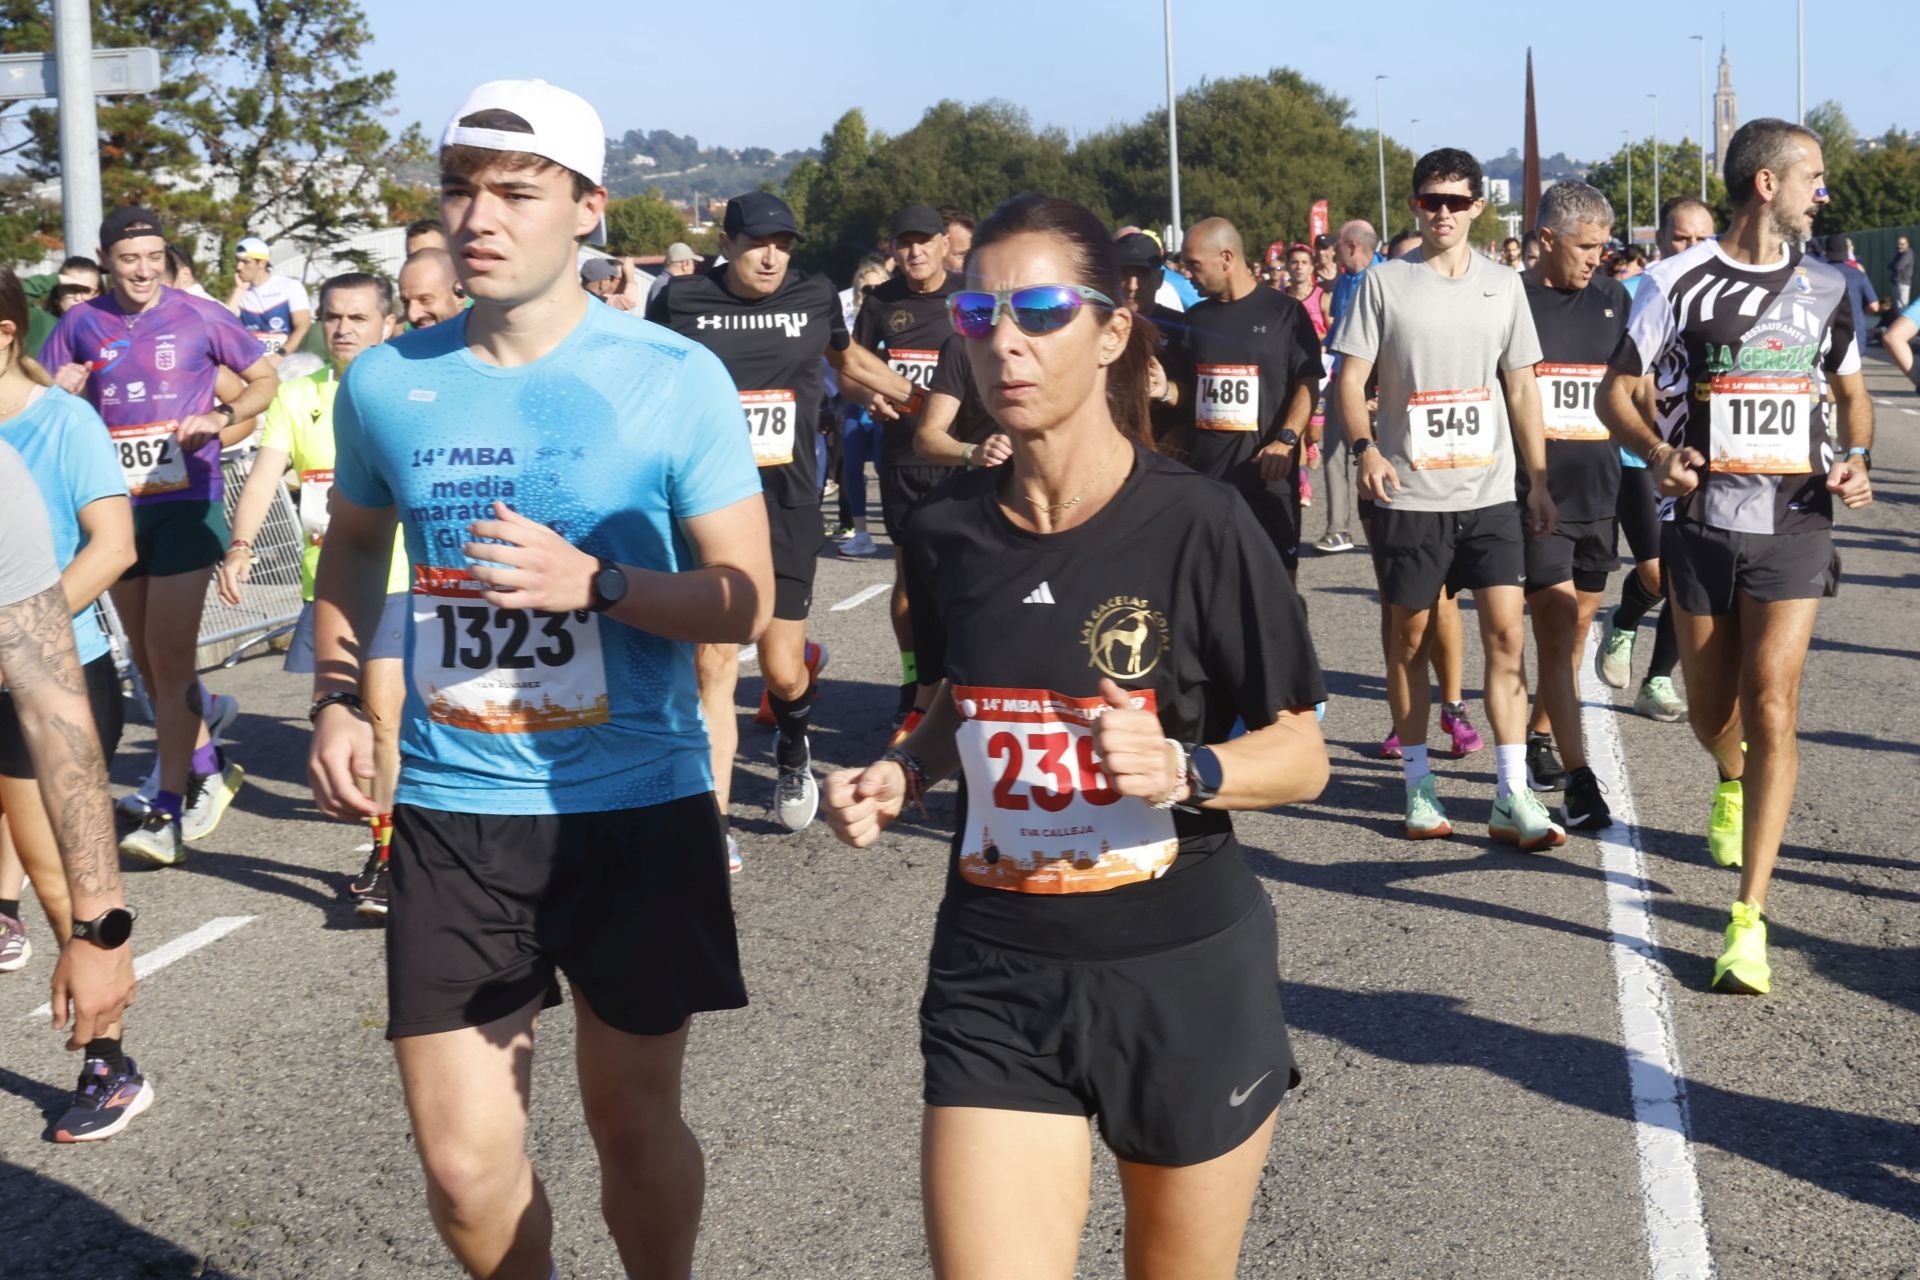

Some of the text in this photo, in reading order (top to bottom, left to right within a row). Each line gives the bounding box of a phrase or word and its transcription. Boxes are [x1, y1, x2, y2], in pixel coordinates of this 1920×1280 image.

[1739, 322, 1808, 343] RESTAURANTE
[1704, 342, 1820, 373] LA CEREZA
[1202, 378, 1250, 405] 1486
[1426, 405, 1480, 438] 549
[1729, 399, 1796, 435] 1120
[114, 438, 174, 469] 862
[448, 447, 515, 466] MBA
[431, 475, 515, 498] media
[1090, 595, 1149, 620] GACELAS
[436, 604, 575, 669] 1323
[1002, 699, 1042, 713] MBA
[987, 731, 1124, 813] 236
[1020, 825, 1095, 838] EVA CALLEJA
